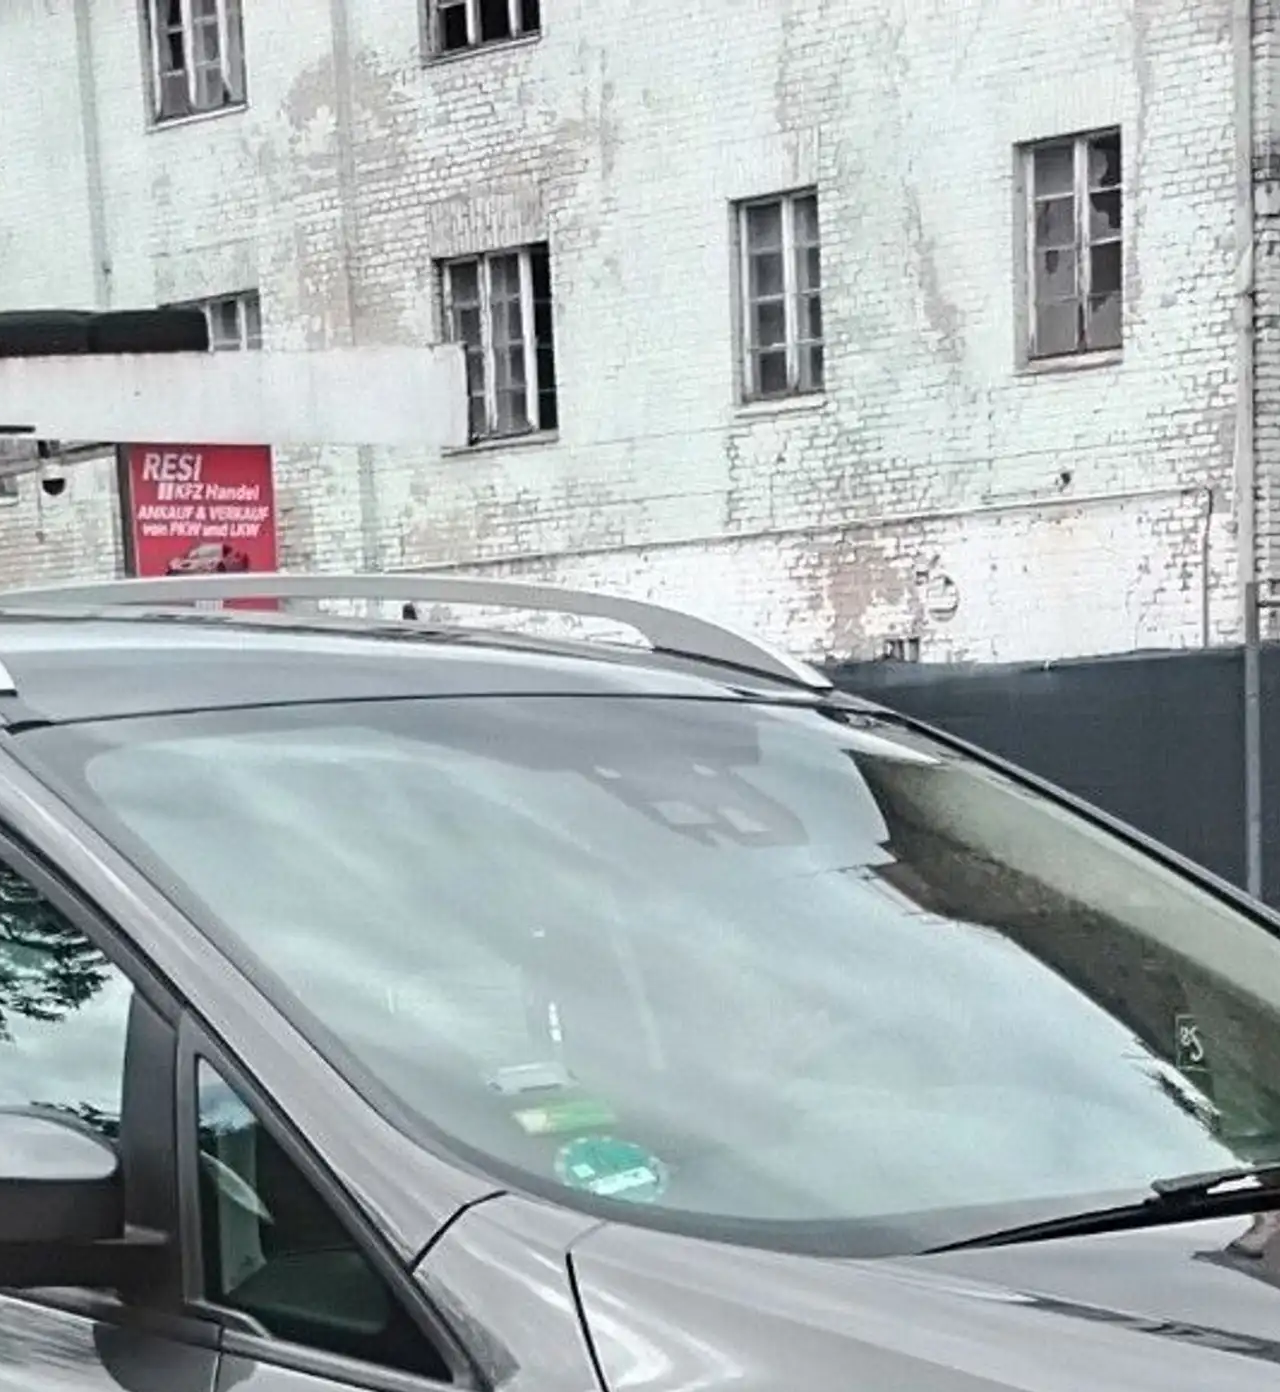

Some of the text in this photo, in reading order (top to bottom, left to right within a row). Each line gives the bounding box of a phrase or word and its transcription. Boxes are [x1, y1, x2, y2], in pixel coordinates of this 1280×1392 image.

[142, 453, 202, 481] RESI
[205, 483, 260, 501] Handel
[138, 505, 195, 520] ANKAUF
[208, 505, 270, 521] VERKAUF
[169, 521, 202, 537] PKW
